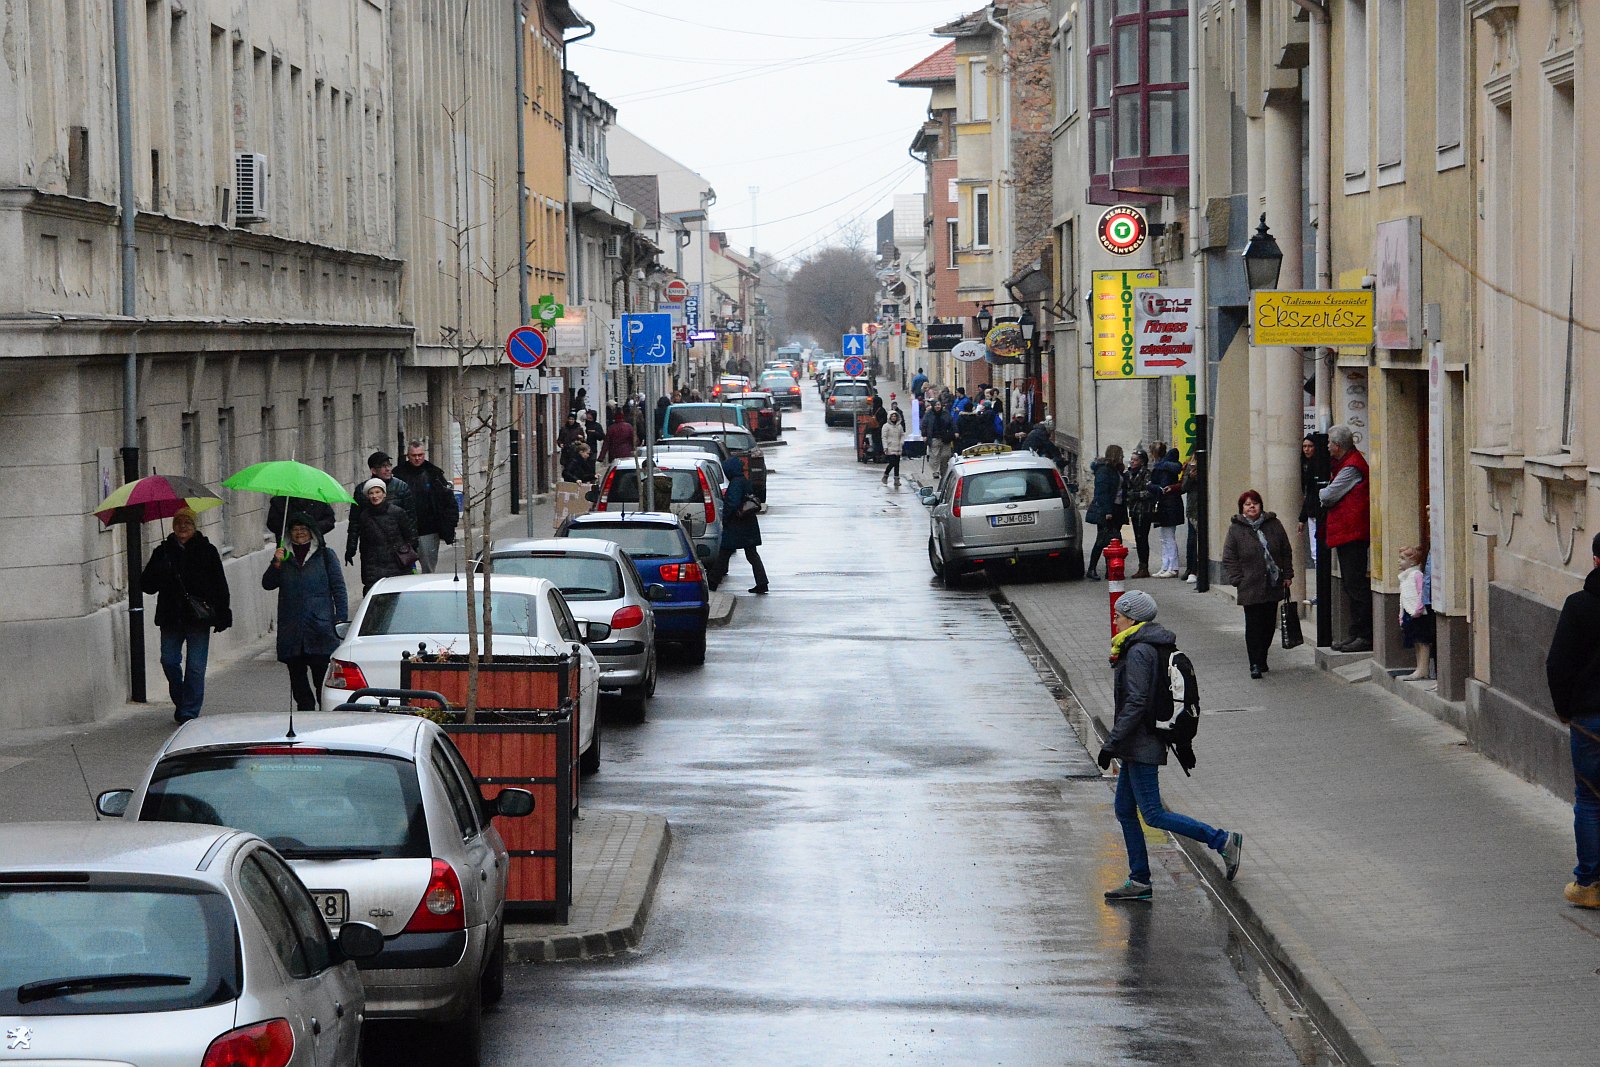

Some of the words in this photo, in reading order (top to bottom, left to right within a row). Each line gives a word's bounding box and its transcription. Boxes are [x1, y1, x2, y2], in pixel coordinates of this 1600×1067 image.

[1105, 208, 1140, 221] NEMZETI
[1117, 225, 1128, 236] T
[1100, 234, 1144, 254] DOHÁNYBOLT
[686, 300, 698, 336] OPTIKA
[1258, 298, 1367, 328] Ékszerész
[627, 320, 644, 343] P
[1121, 272, 1134, 376] LOTTÓZÓ
[1143, 320, 1189, 334] Fitness
